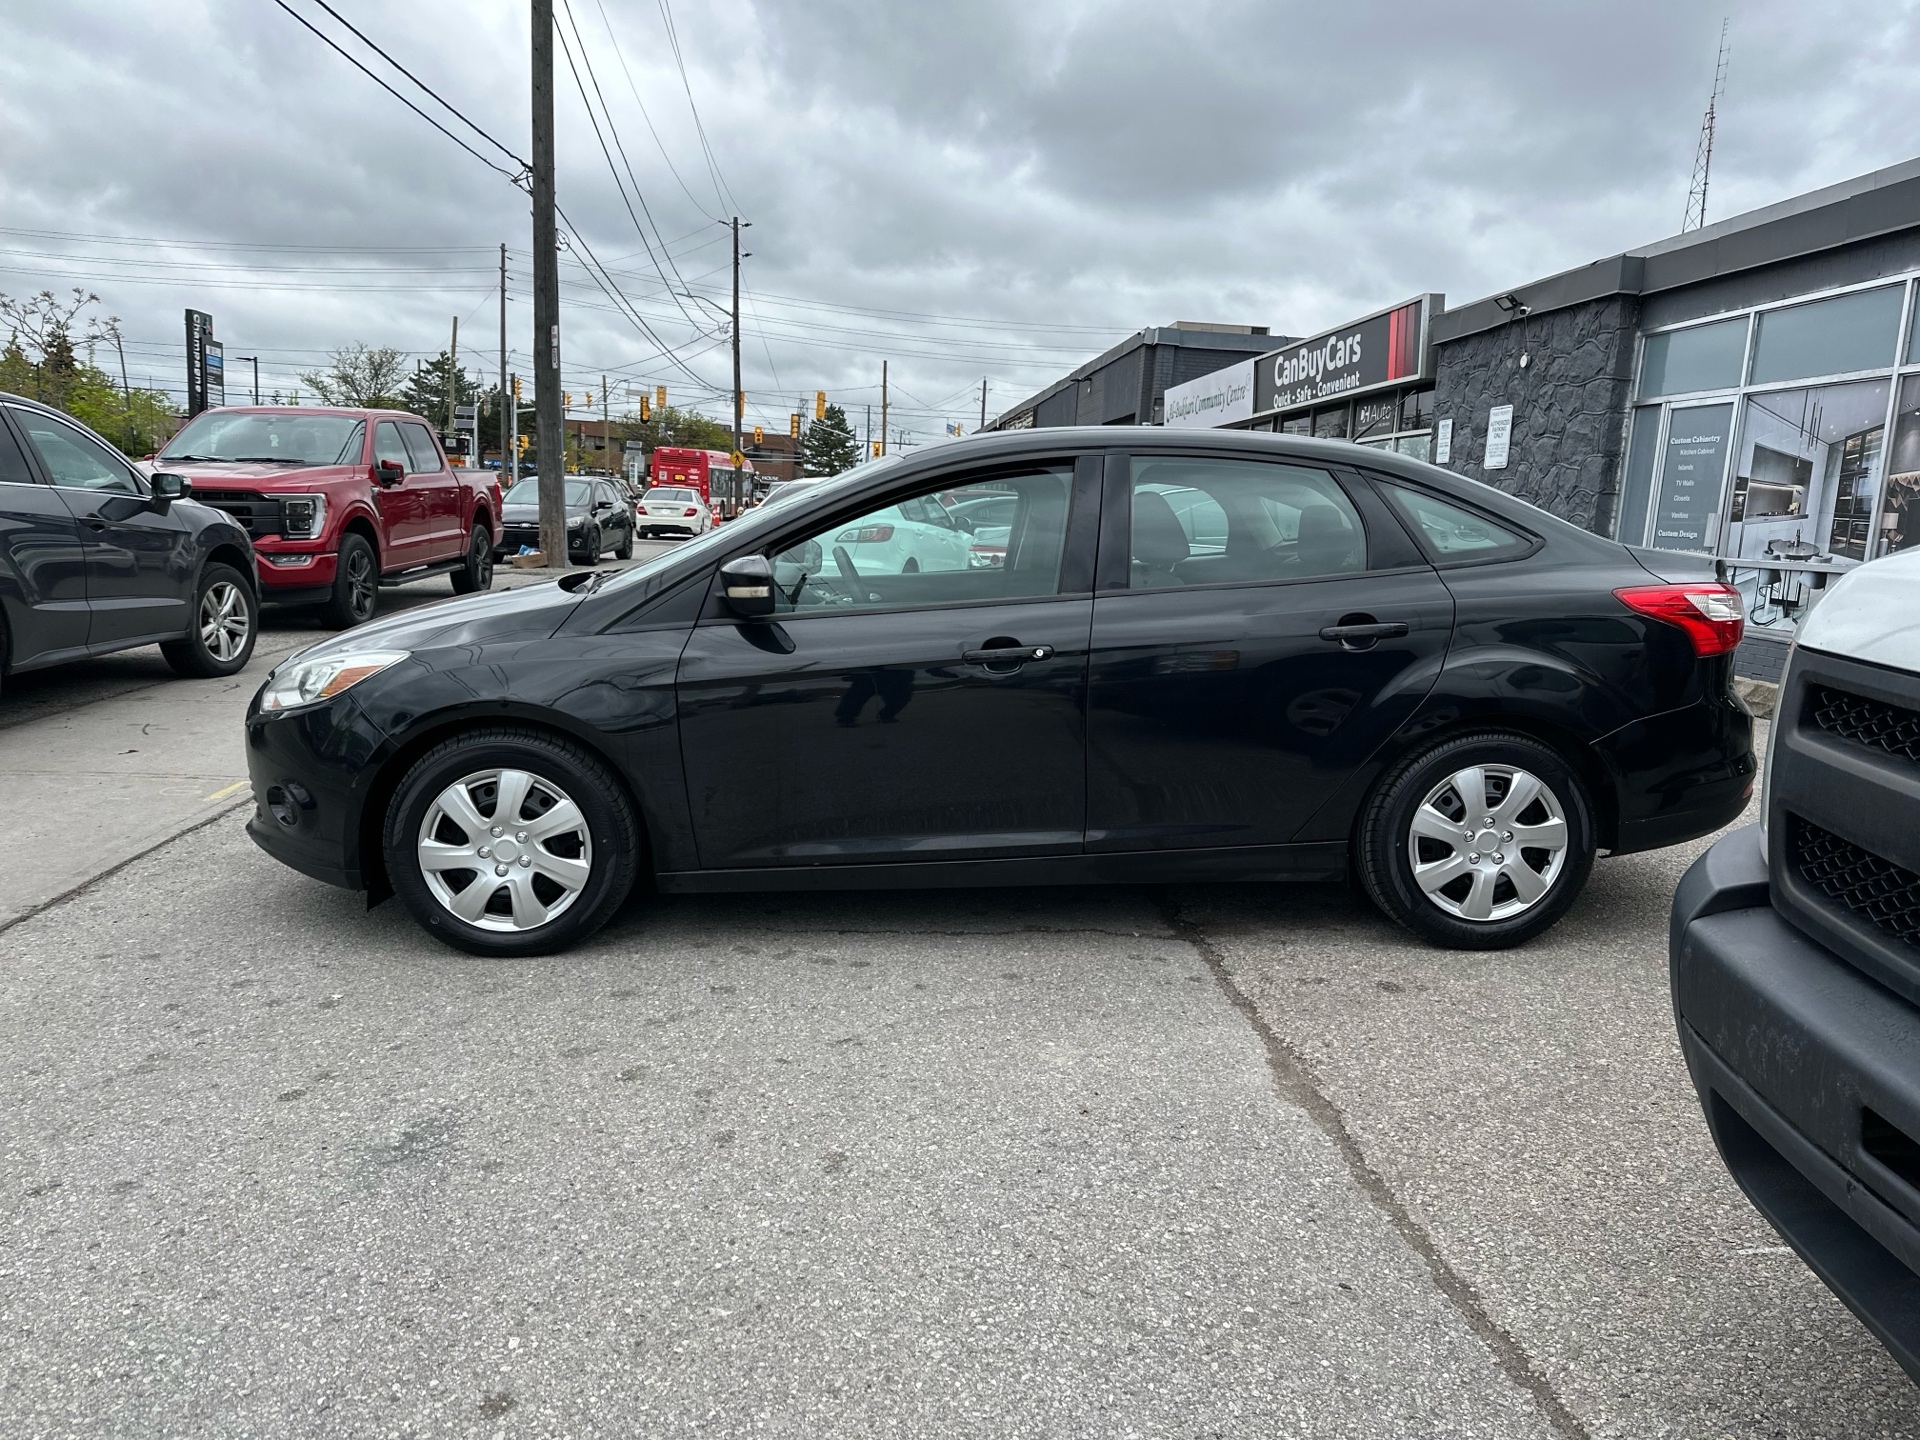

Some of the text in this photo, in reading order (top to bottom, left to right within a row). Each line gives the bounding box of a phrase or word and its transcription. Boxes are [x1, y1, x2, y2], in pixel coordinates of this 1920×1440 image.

[193, 313, 202, 393] Champagne
[1274, 333, 1362, 387] CanBuyCars
[1195, 388, 1225, 413] Community
[1226, 380, 1248, 406] Centre
[1273, 390, 1291, 409] Quick
[1296, 384, 1312, 403] Safe
[1317, 370, 1360, 396] Convenient
[1692, 435, 1721, 444] Cabinetry
[1657, 529, 1698, 539] Custom Design
